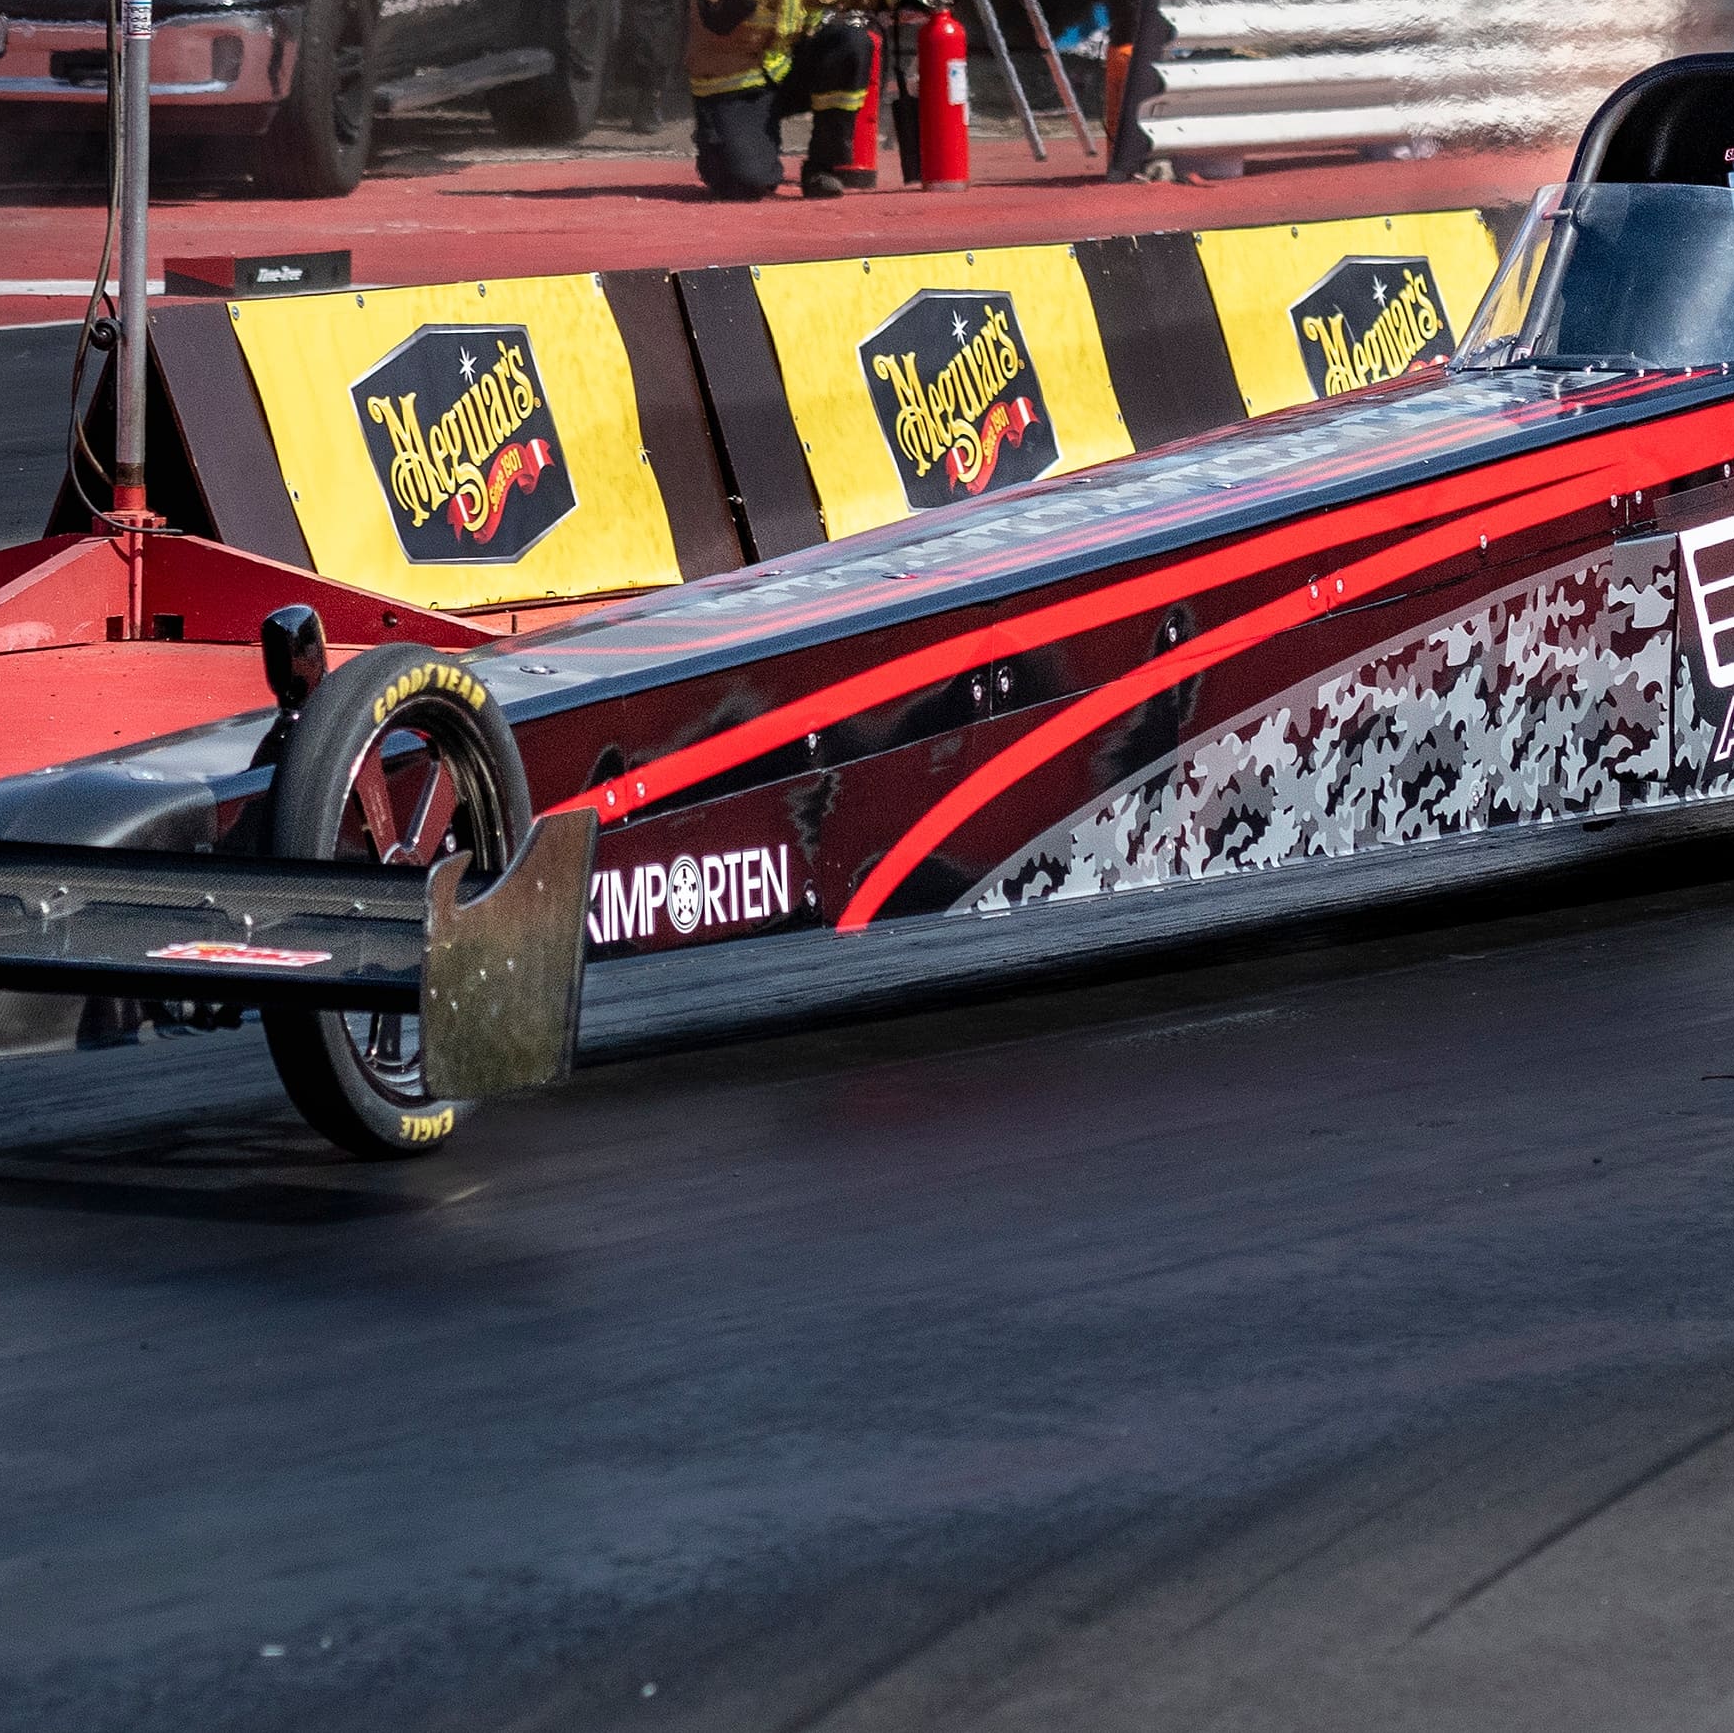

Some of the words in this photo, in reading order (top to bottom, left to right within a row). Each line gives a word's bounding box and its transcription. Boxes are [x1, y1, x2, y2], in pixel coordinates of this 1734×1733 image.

[873, 304, 1020, 484] Meguiar's
[368, 339, 535, 533] Meguiar's
[500, 447, 524, 482] 1901
[373, 662, 488, 725] GOODYEAR
[398, 1106, 455, 1143] EAGLE
